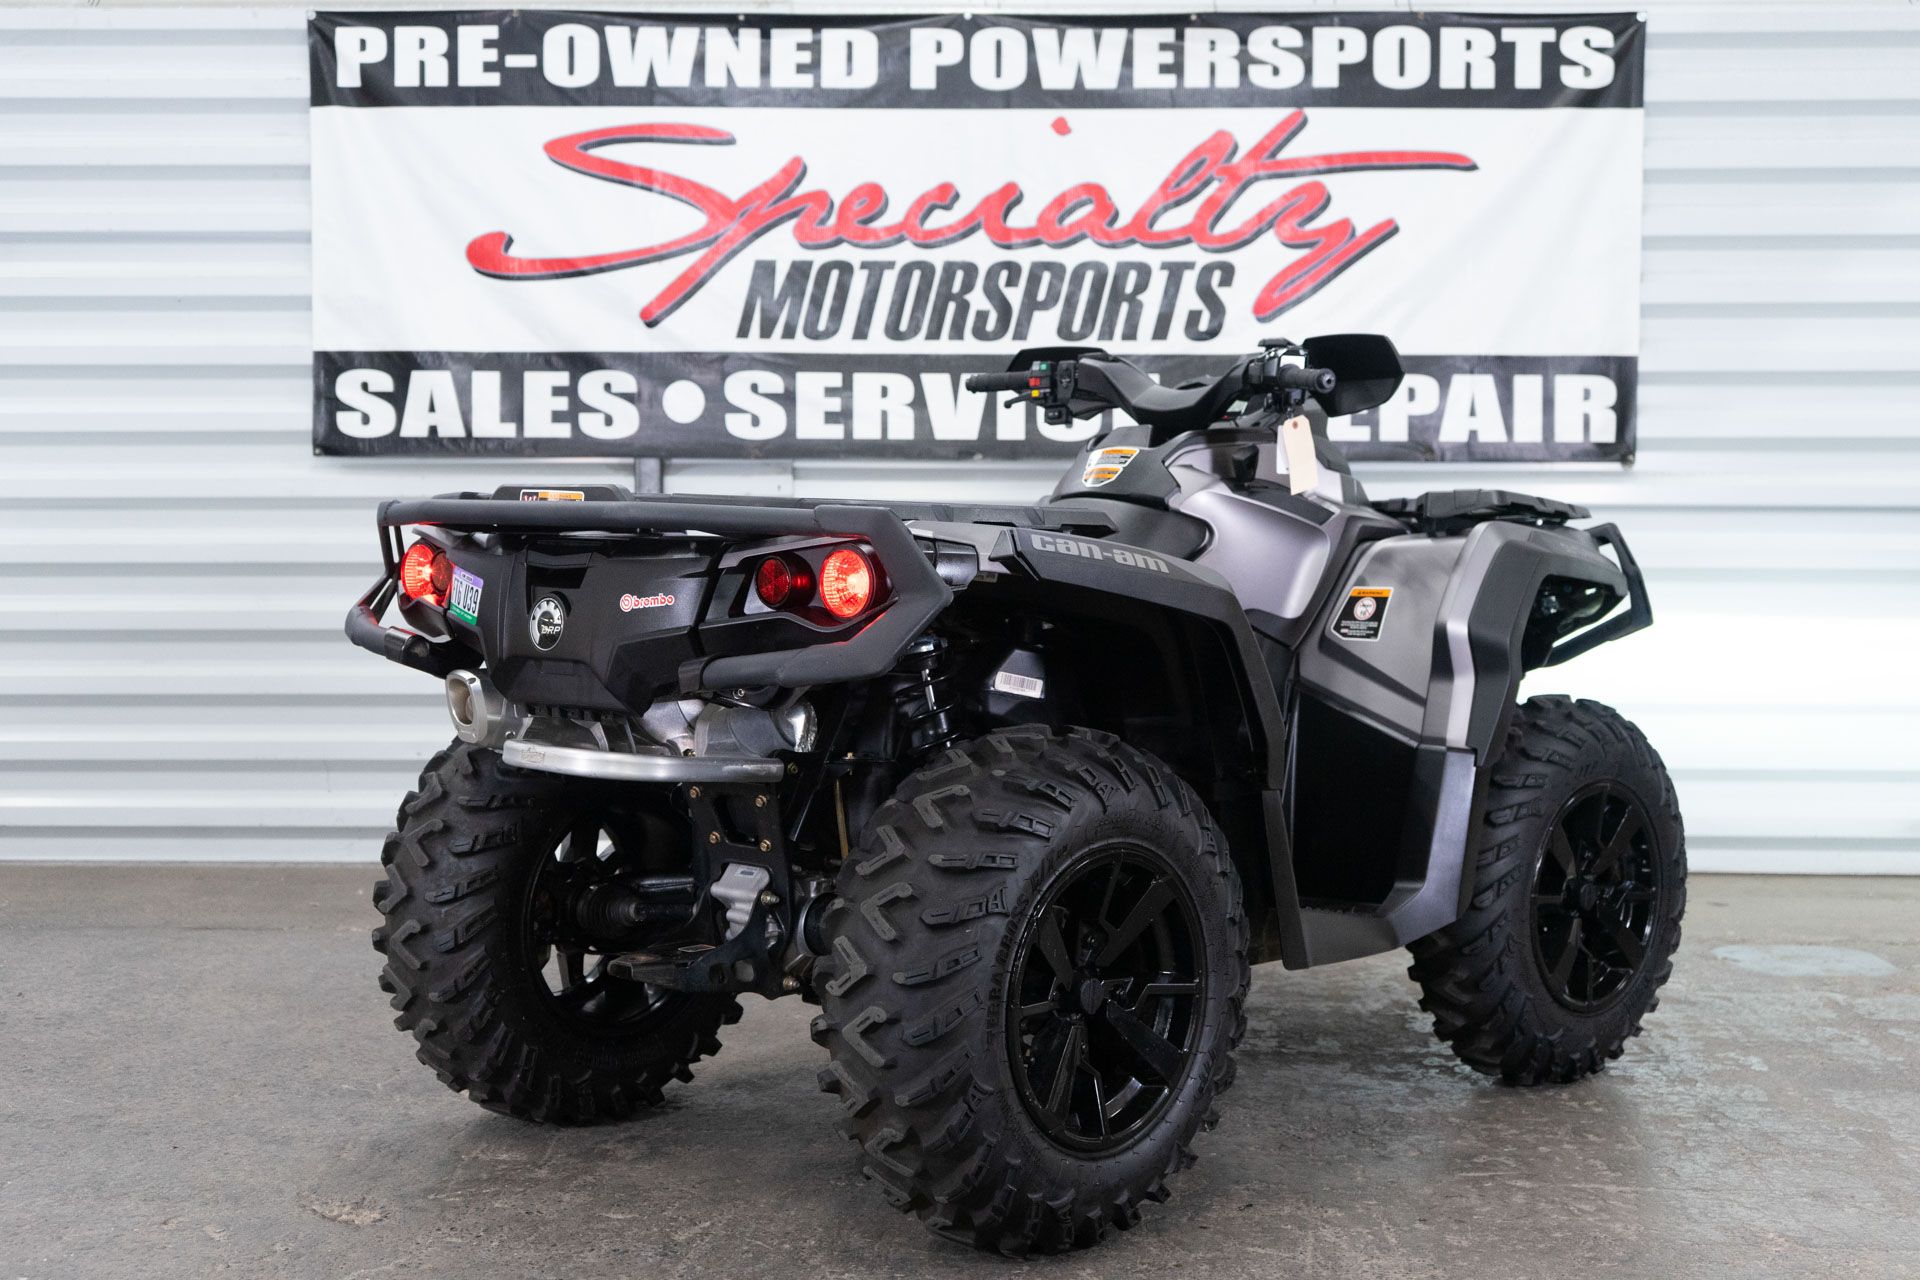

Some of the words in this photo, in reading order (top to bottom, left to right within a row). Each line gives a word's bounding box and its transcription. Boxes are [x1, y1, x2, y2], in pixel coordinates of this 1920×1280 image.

[334, 23, 879, 90] PRE-OWNED
[910, 25, 1616, 90] POWERSPORTS
[466, 109, 1478, 328] Specialty
[736, 259, 1235, 342] MOTORSPORTS
[334, 369, 640, 440] SALES
[724, 371, 1160, 443] SERVI
[631, 593, 675, 610] brembo
